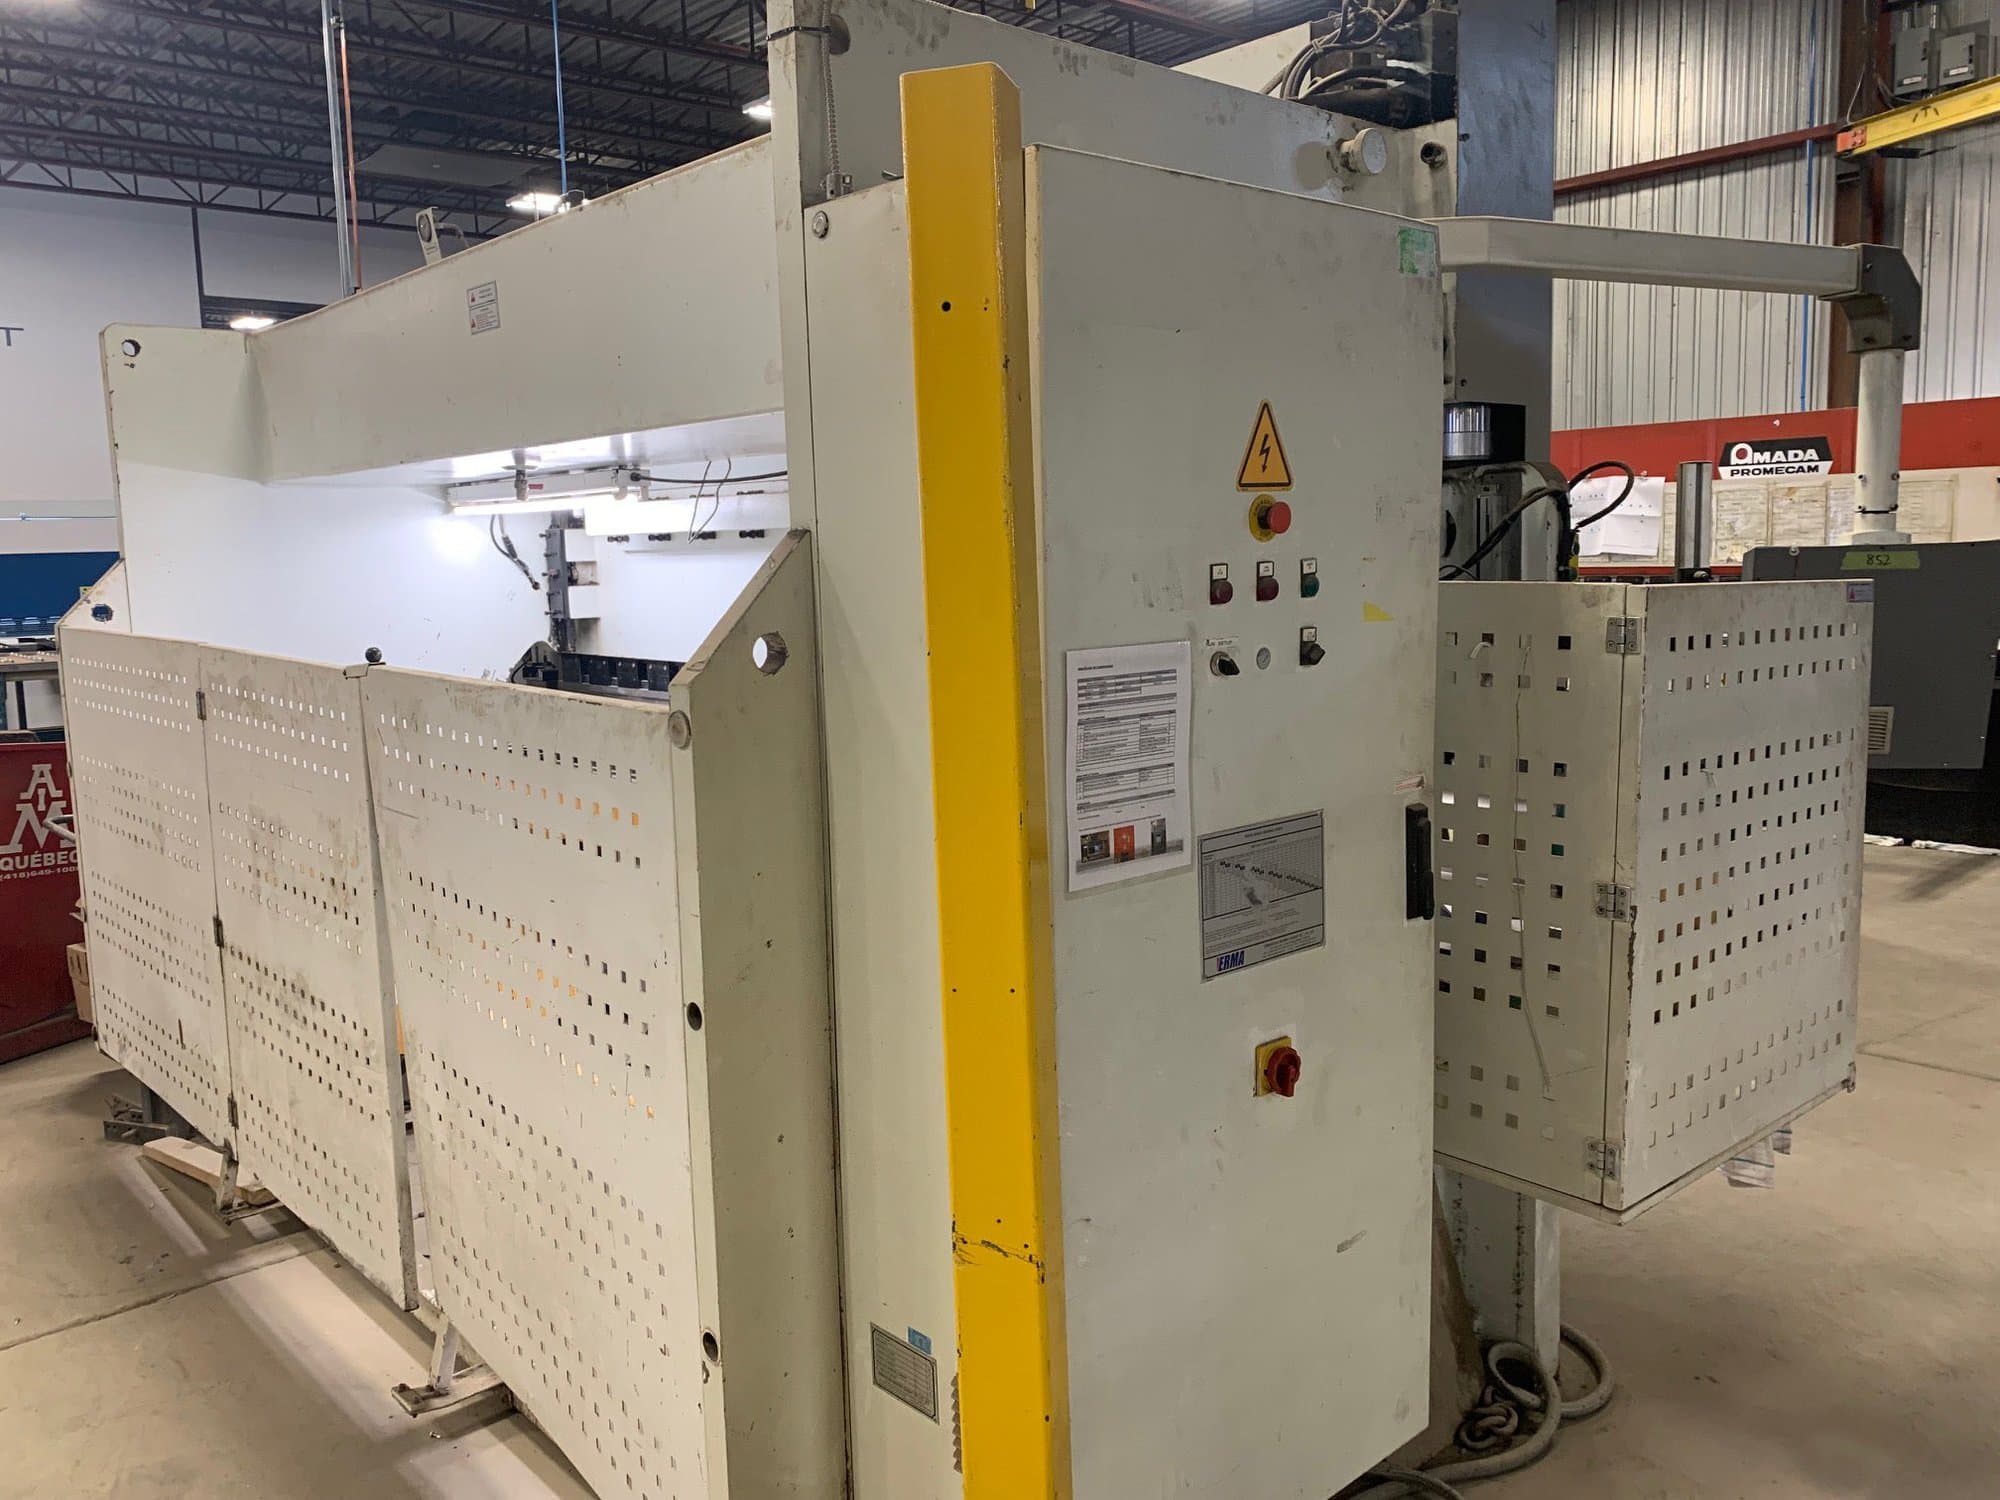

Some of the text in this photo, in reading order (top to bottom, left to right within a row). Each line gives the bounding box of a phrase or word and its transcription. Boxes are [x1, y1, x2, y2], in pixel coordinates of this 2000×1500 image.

[1730, 443, 1819, 465] AMADA
[1730, 465, 1819, 476] PROMECAM
[1866, 554, 1890, 566] 852
[0, 866, 78, 881] (418)649-100
